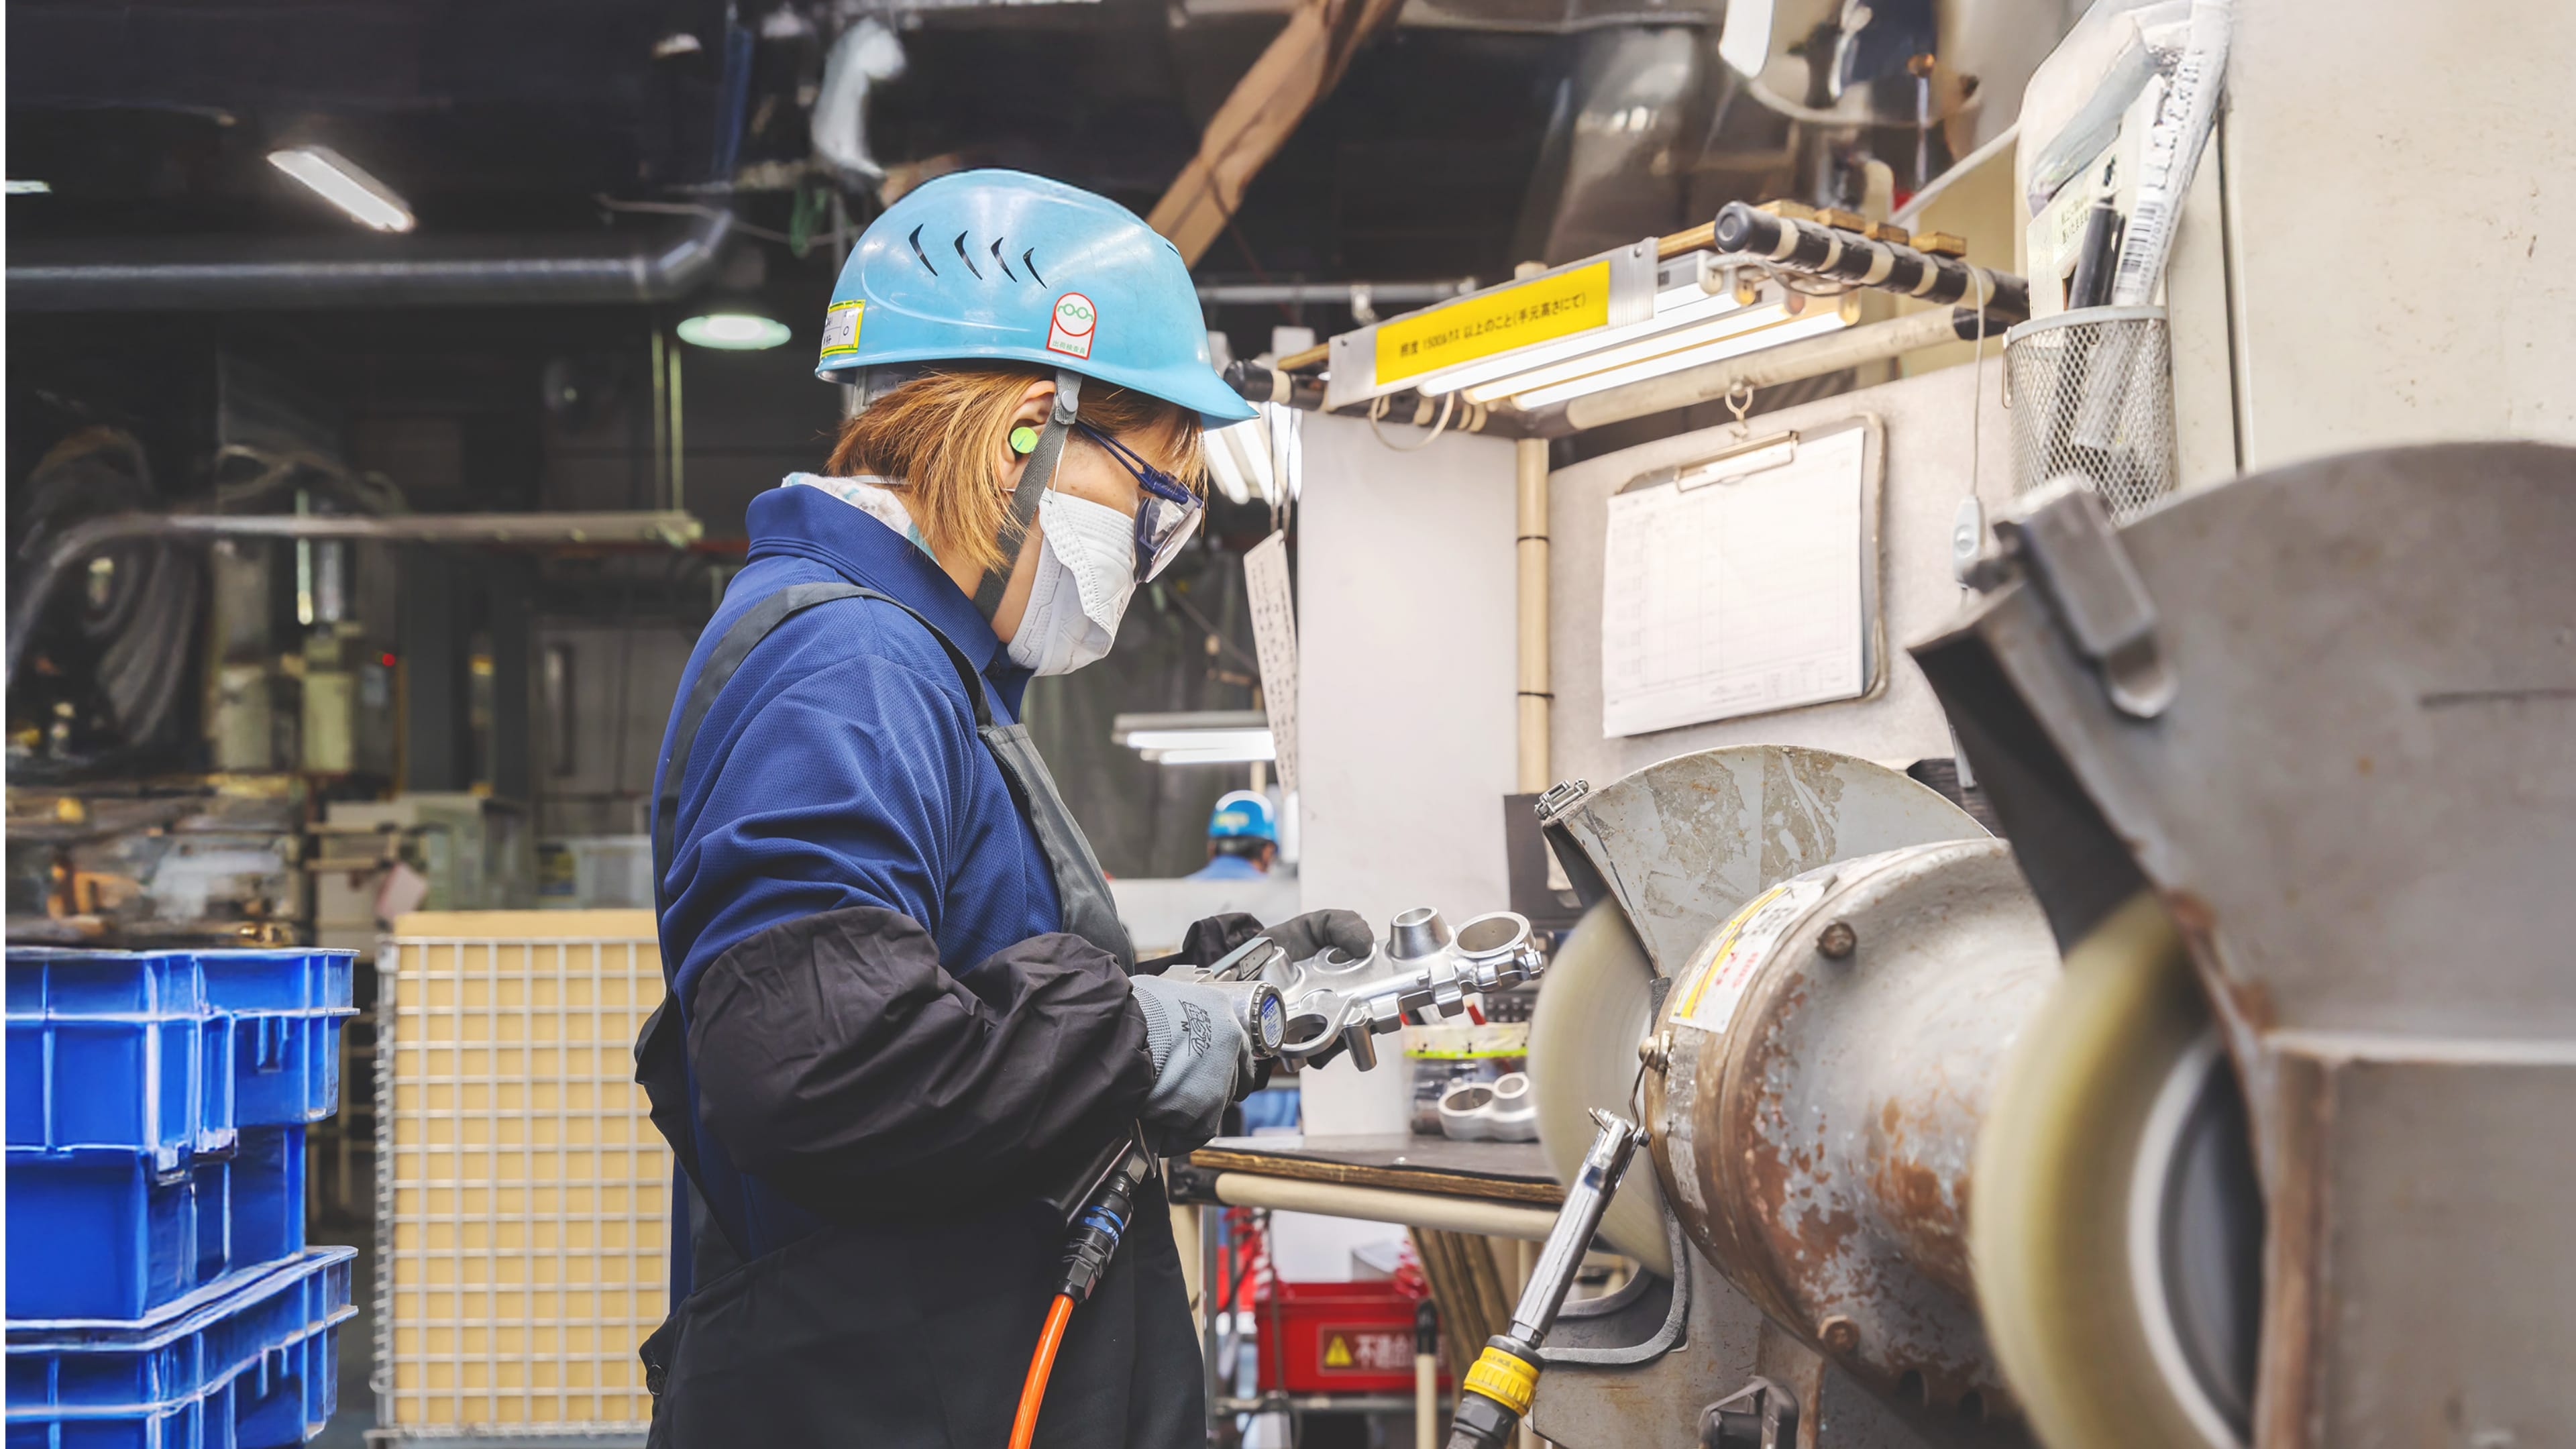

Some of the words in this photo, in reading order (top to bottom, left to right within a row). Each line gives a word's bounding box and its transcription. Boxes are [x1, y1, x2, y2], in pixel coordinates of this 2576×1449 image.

[1051, 339, 1085, 355] 出荷検査員
[1180, 1020, 1189, 1032] M
